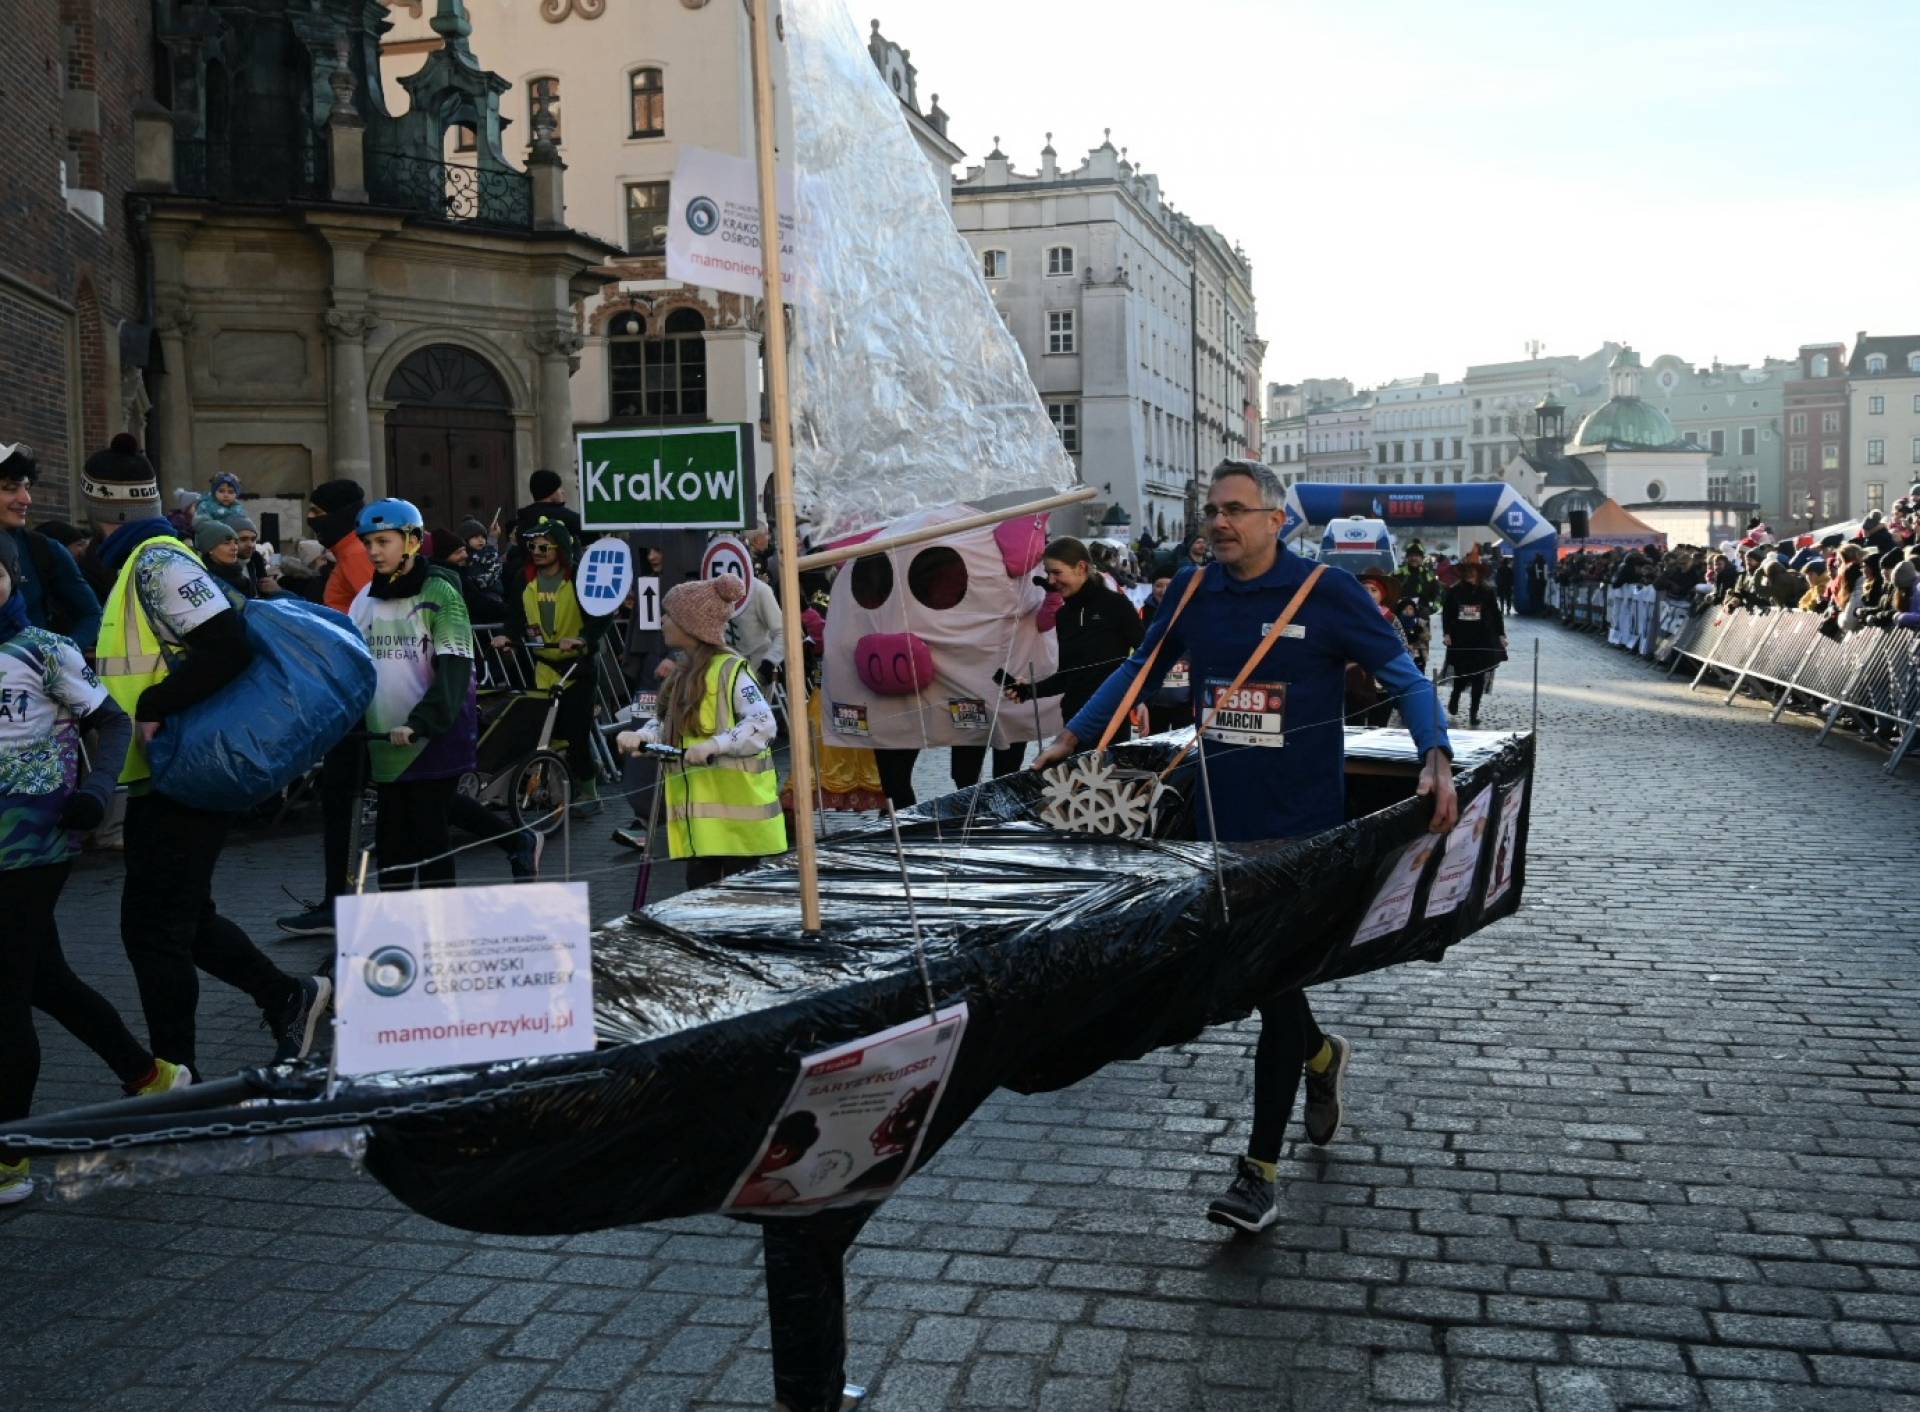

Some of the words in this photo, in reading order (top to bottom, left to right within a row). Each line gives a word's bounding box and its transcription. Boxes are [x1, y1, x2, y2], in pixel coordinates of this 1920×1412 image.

[721, 230, 762, 249] OŚROD
[586, 457, 735, 502] Kraków
[1388, 501, 1424, 514] BIEG
[1216, 711, 1263, 730] MARCIN
[424, 957, 524, 977] KRAKOWSKI
[424, 973, 505, 995] OŚRODEK
[511, 971, 574, 988] KARIERY
[378, 1010, 574, 1044] mamonieryzykuj.pl
[808, 1056, 937, 1096] ZARYZYKUJESZ?
